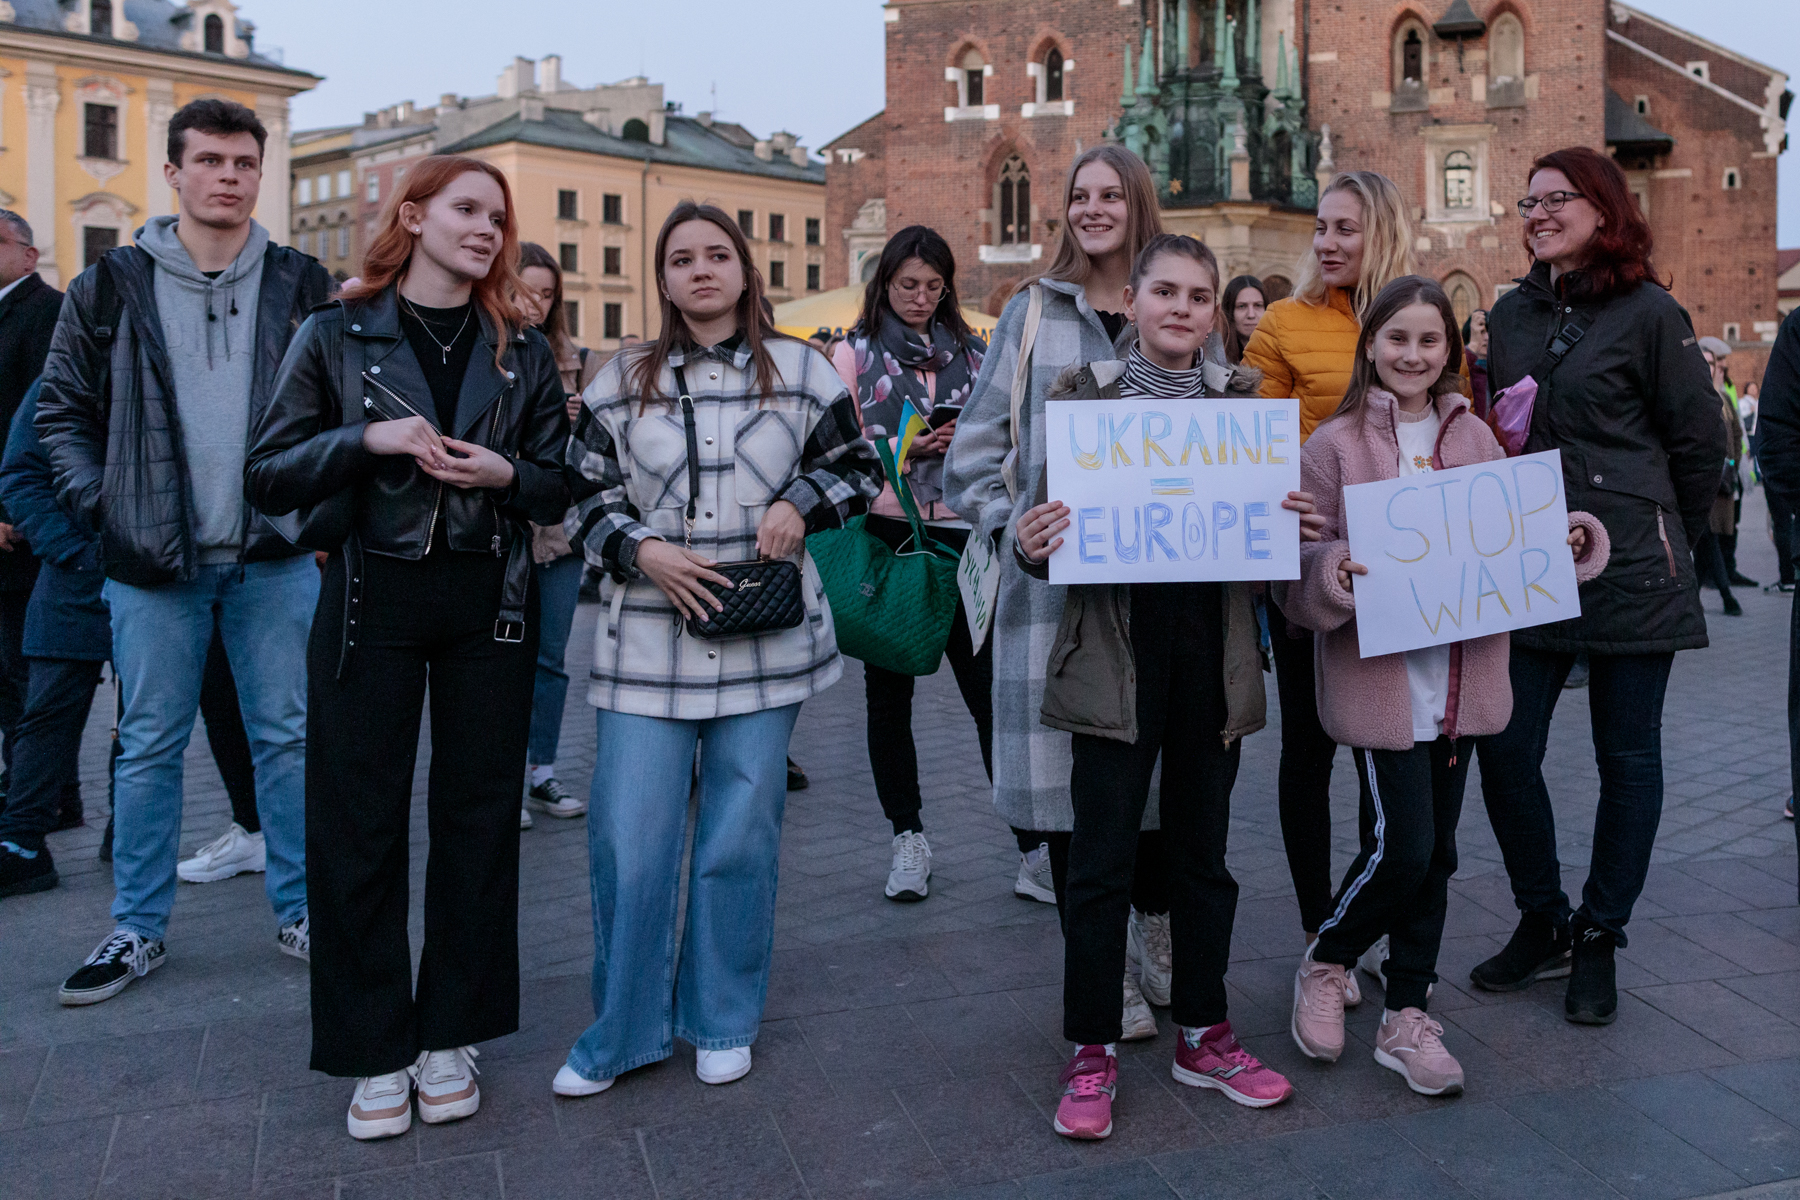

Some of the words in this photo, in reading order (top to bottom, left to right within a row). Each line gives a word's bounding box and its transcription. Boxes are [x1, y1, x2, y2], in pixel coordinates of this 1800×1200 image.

[1069, 410, 1289, 470] UKRAINE
[1078, 501, 1272, 564] EUROPE
[1384, 460, 1559, 563] STOP
[1409, 548, 1560, 636] WAR
